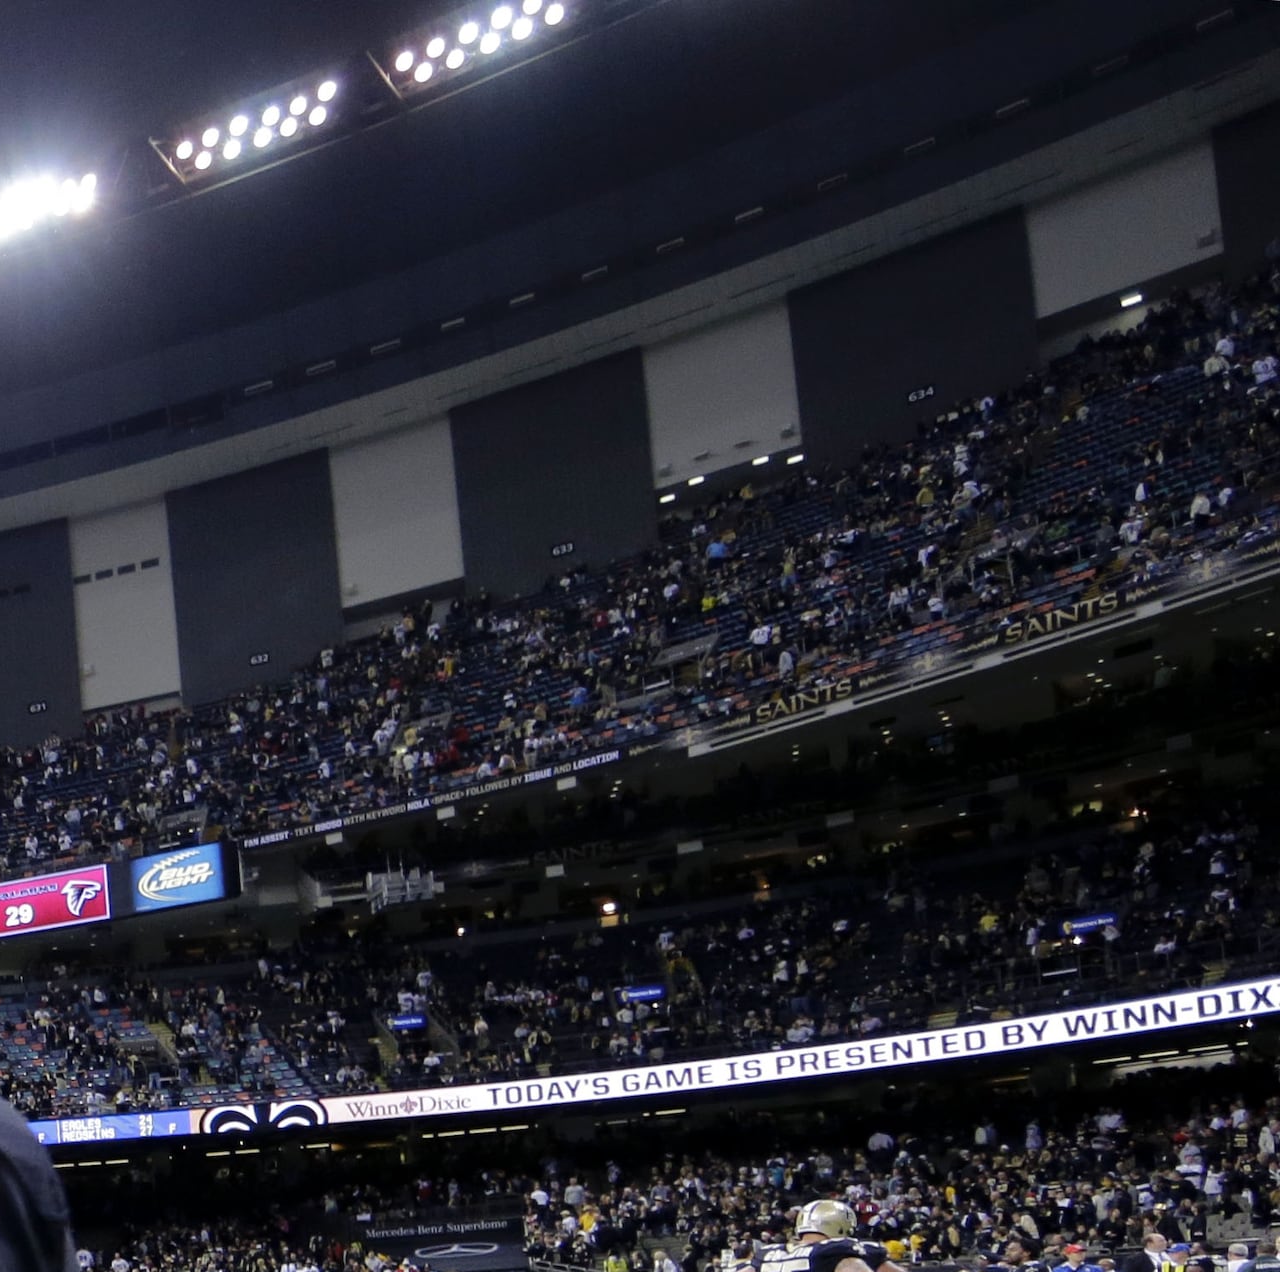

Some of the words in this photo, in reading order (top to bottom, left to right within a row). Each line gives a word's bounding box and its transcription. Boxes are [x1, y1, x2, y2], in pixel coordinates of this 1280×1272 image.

[908, 386, 934, 401] 634
[552, 543, 573, 555] 633
[1004, 592, 1118, 645] SAINTS
[755, 676, 852, 725] SAINTS
[294, 826, 314, 837] TEXT
[343, 814, 366, 826] WITH
[366, 804, 406, 820] KEYWORD
[407, 799, 430, 811] NOLA
[466, 778, 510, 797] FOLLOWED
[511, 775, 523, 787] BY
[524, 768, 552, 783] ISSUE
[553, 763, 571, 775] AND
[572, 751, 619, 771] LOCATION
[149, 870, 214, 892] LIGHT
[159, 862, 210, 881] BUD
[5, 903, 34, 927] 29
[487, 1077, 610, 1107] TODAY'S
[622, 1065, 714, 1093] GAME
[726, 1059, 762, 1081] IS
[776, 1029, 986, 1076] PRESENTED
[1002, 1020, 1049, 1047] BY
[1063, 983, 1280, 1037] WINN-DIX
[345, 1101, 399, 1119] Winn
[418, 1095, 471, 1114] Dixie
[62, 1118, 102, 1131] EAGLES
[139, 1114, 153, 1126] 24
[62, 1128, 115, 1142] REDSKINS
[139, 1126, 153, 1137] 27
[366, 1225, 444, 1239] Mercedes-Benz
[446, 1220, 508, 1233] Superdome
